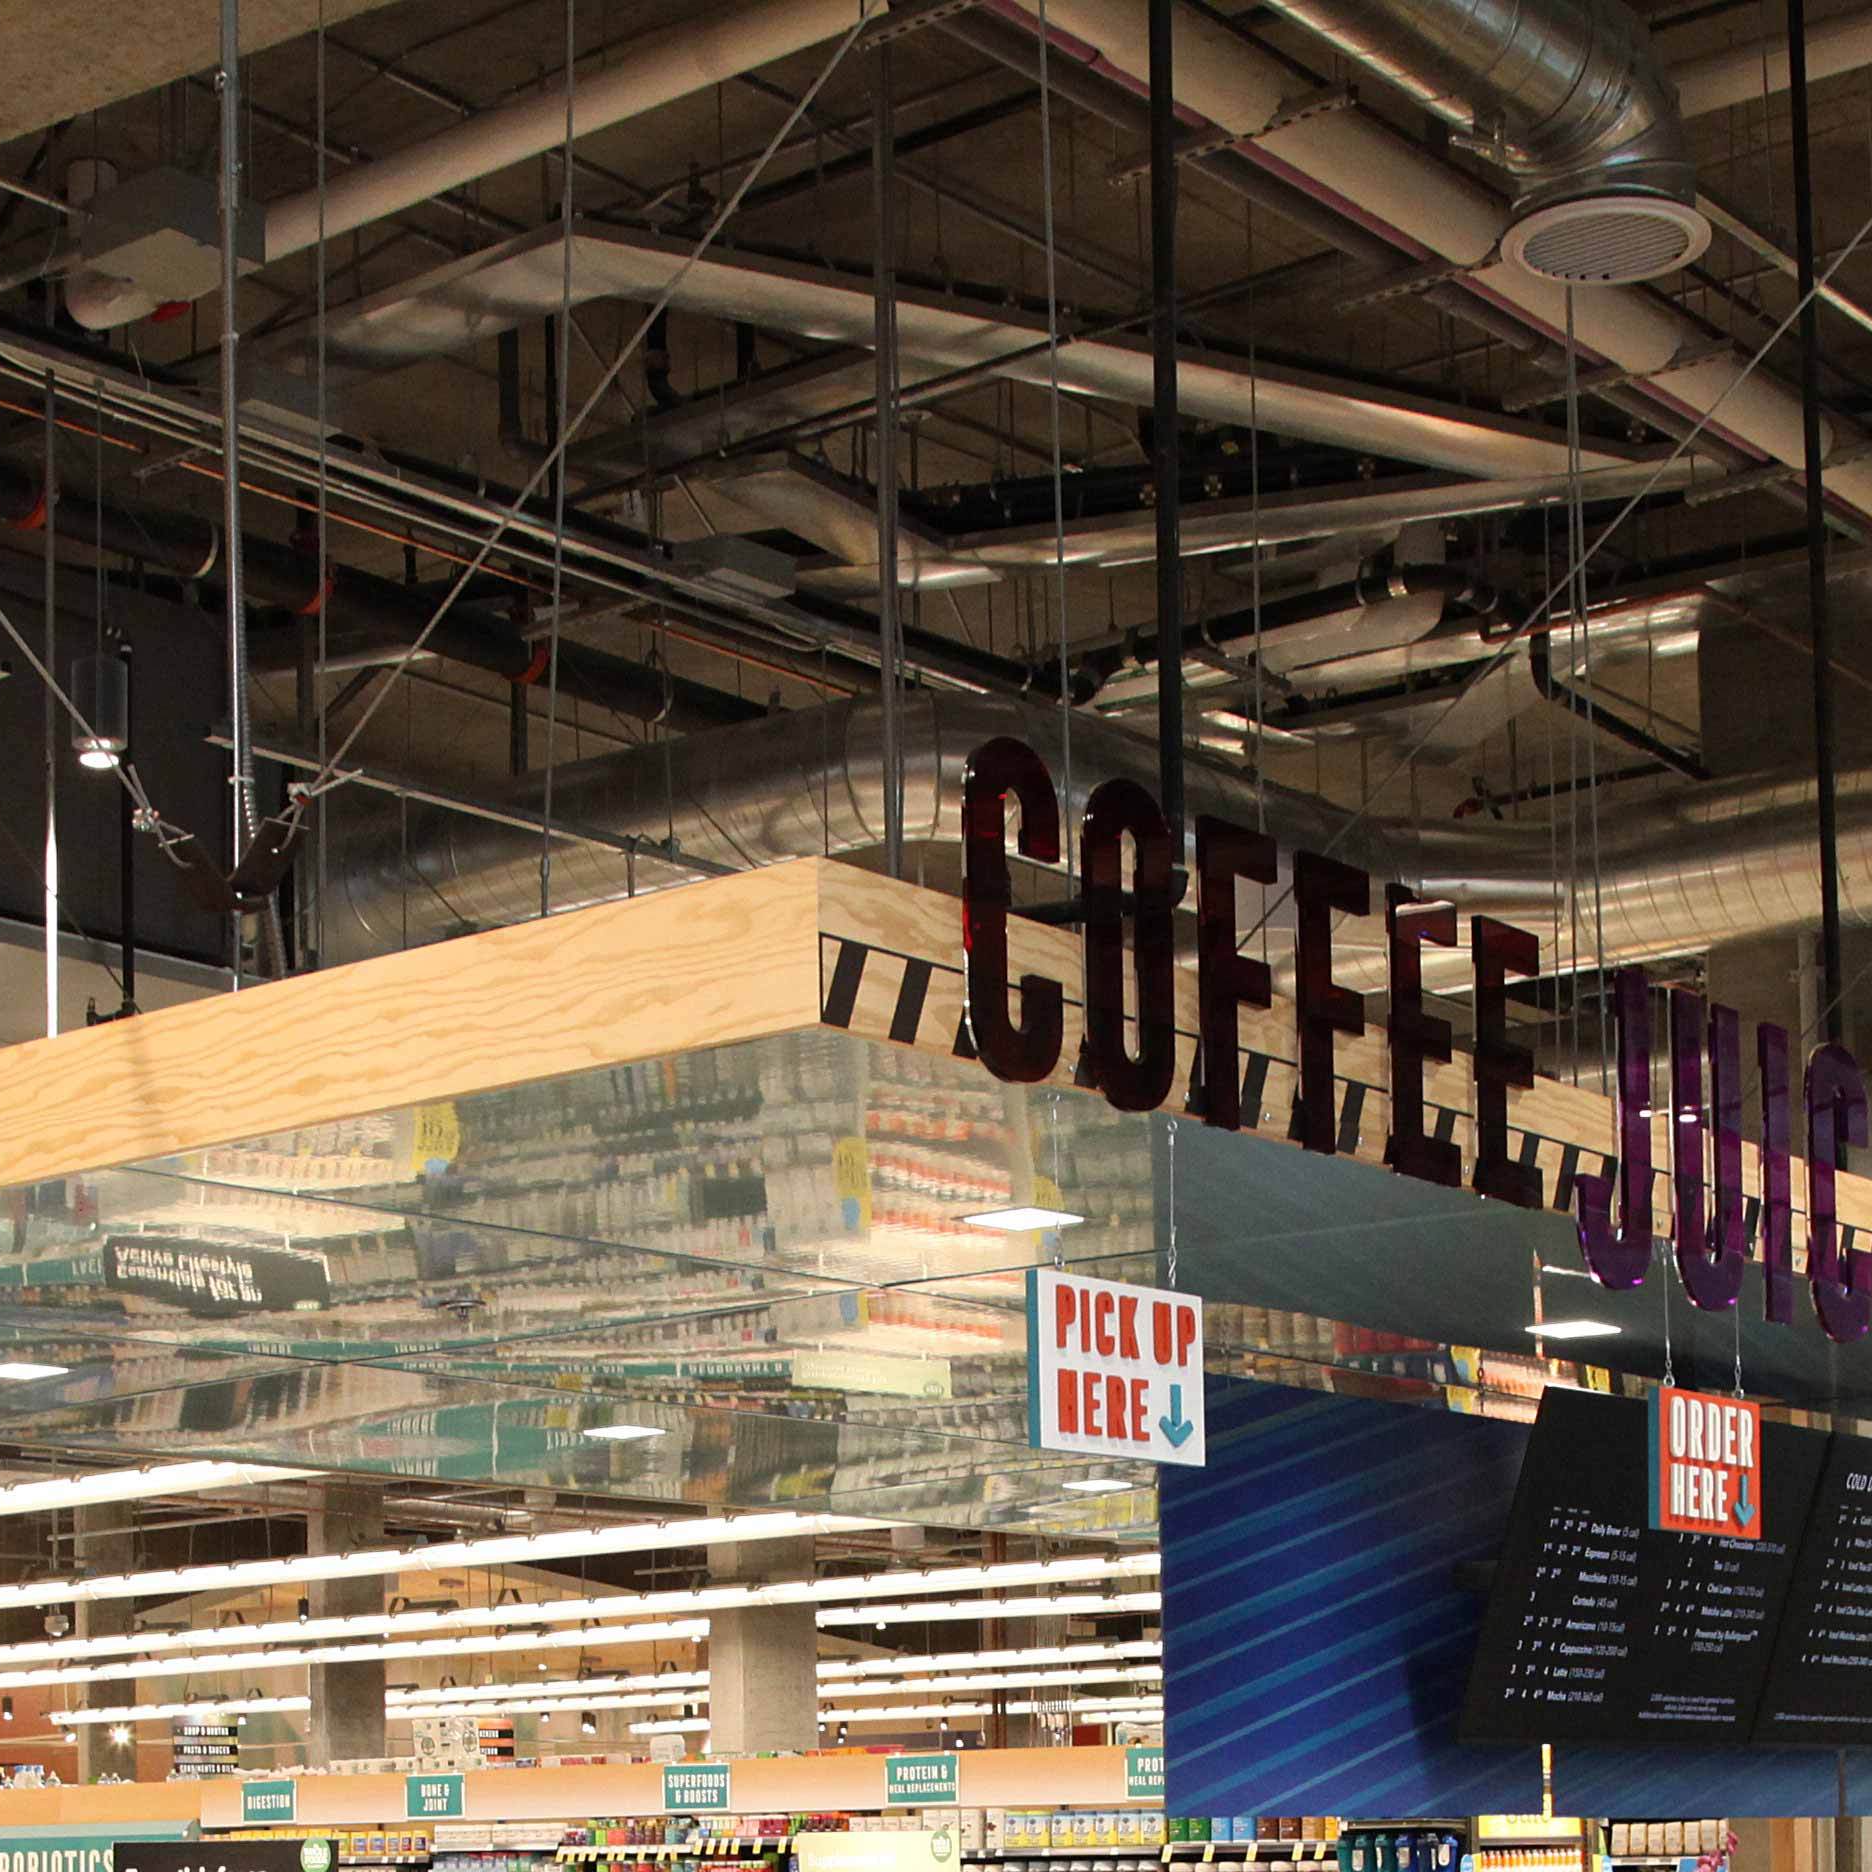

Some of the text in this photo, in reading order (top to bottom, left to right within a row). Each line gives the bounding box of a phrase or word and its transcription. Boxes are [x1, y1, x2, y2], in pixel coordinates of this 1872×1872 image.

[962, 736, 1544, 1209] COFFEE
[1054, 1283, 1196, 1368] PICK UP
[1056, 1376, 1150, 1441] HERE
[1668, 1396, 1753, 1469] ORDER
[1846, 1473, 1868, 1492] COLD
[1668, 1464, 1730, 1523] HERE
[1137, 1757, 1165, 1772] PROT
[668, 1773, 725, 1789] SUPERFOODS
[896, 1766, 939, 1782] PROTEIN
[420, 1783, 441, 1798] BONE
[682, 1789, 719, 1804] BOOSTS
[888, 1782, 957, 1795] MEAL REPLACEMENTS
[247, 1794, 290, 1809] DIGESTION
[423, 1797, 449, 1812] JOINT
